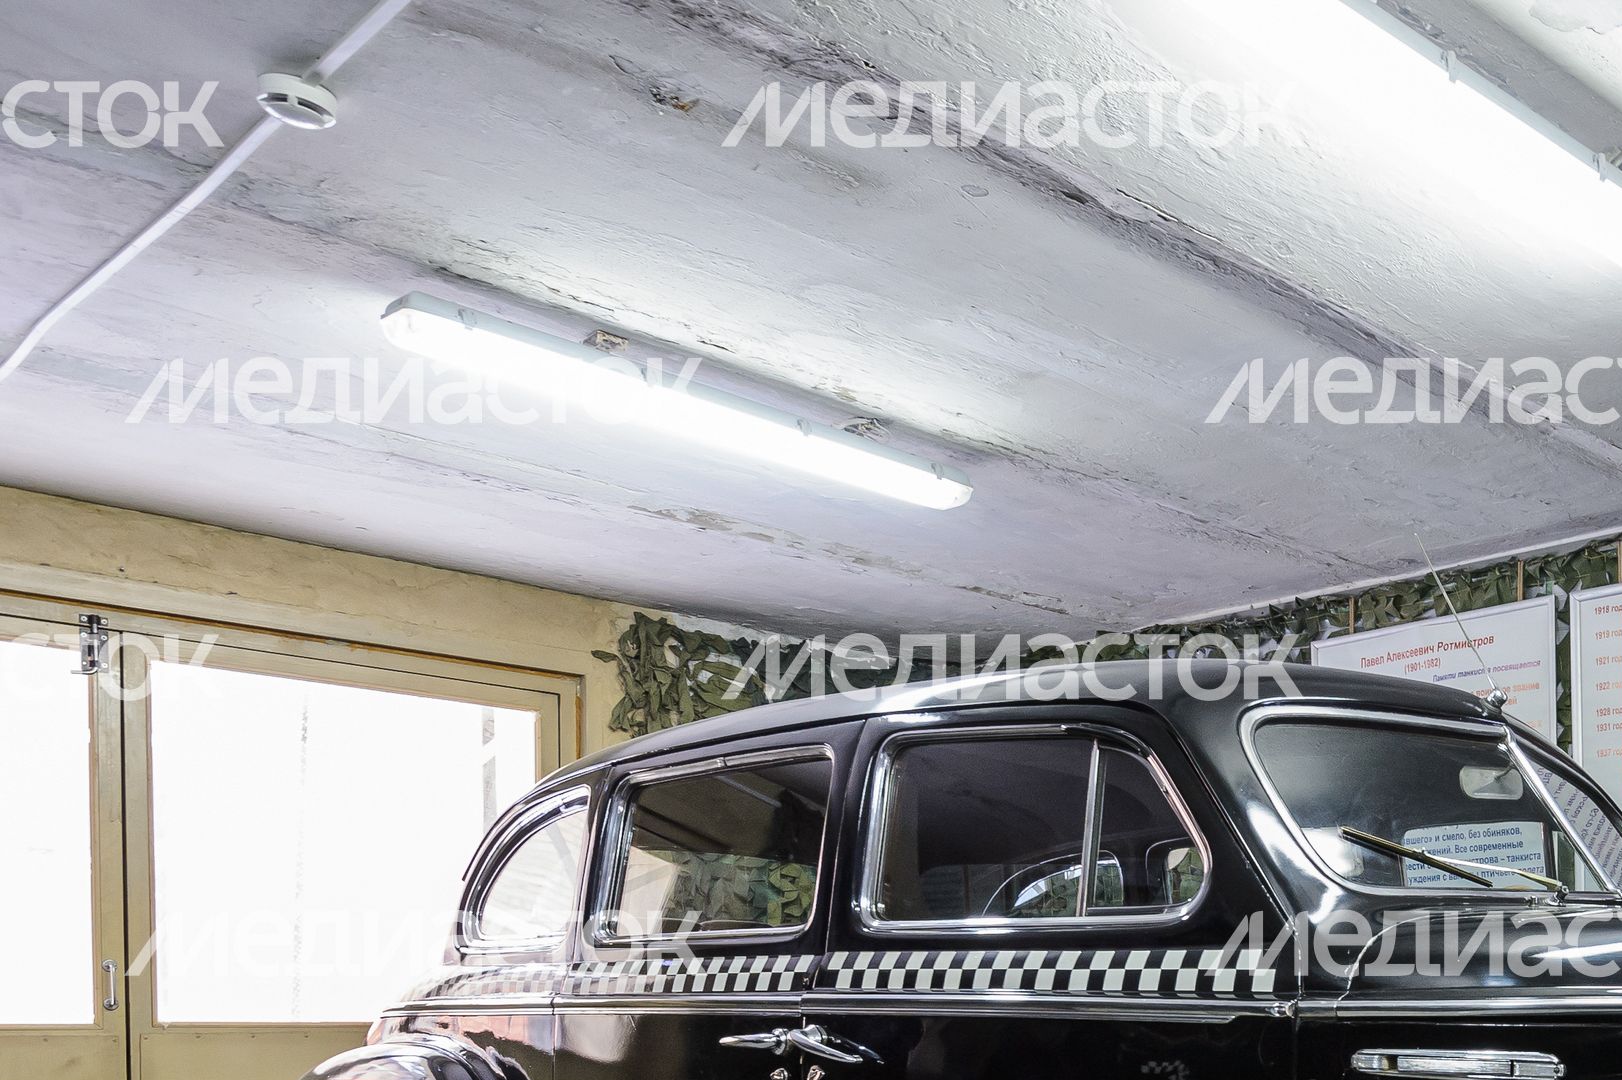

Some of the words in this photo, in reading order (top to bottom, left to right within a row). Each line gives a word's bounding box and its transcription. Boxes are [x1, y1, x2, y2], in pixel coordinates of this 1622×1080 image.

[1360, 655, 1385, 668] Павел
[1386, 644, 1435, 663] Алексеевич
[1437, 635, 1495, 652] Ротмистров
[1404, 658, 1441, 675] (1901-1982)
[1432, 671, 1457, 683] Памяти
[1457, 667, 1492, 680] танкиств
[1441, 832, 1467, 842] смело,
[1468, 829, 1481, 838] без
[1482, 826, 1523, 838] обиняков,
[1455, 843, 1468, 853] Все
[1469, 840, 1524, 853] современные
